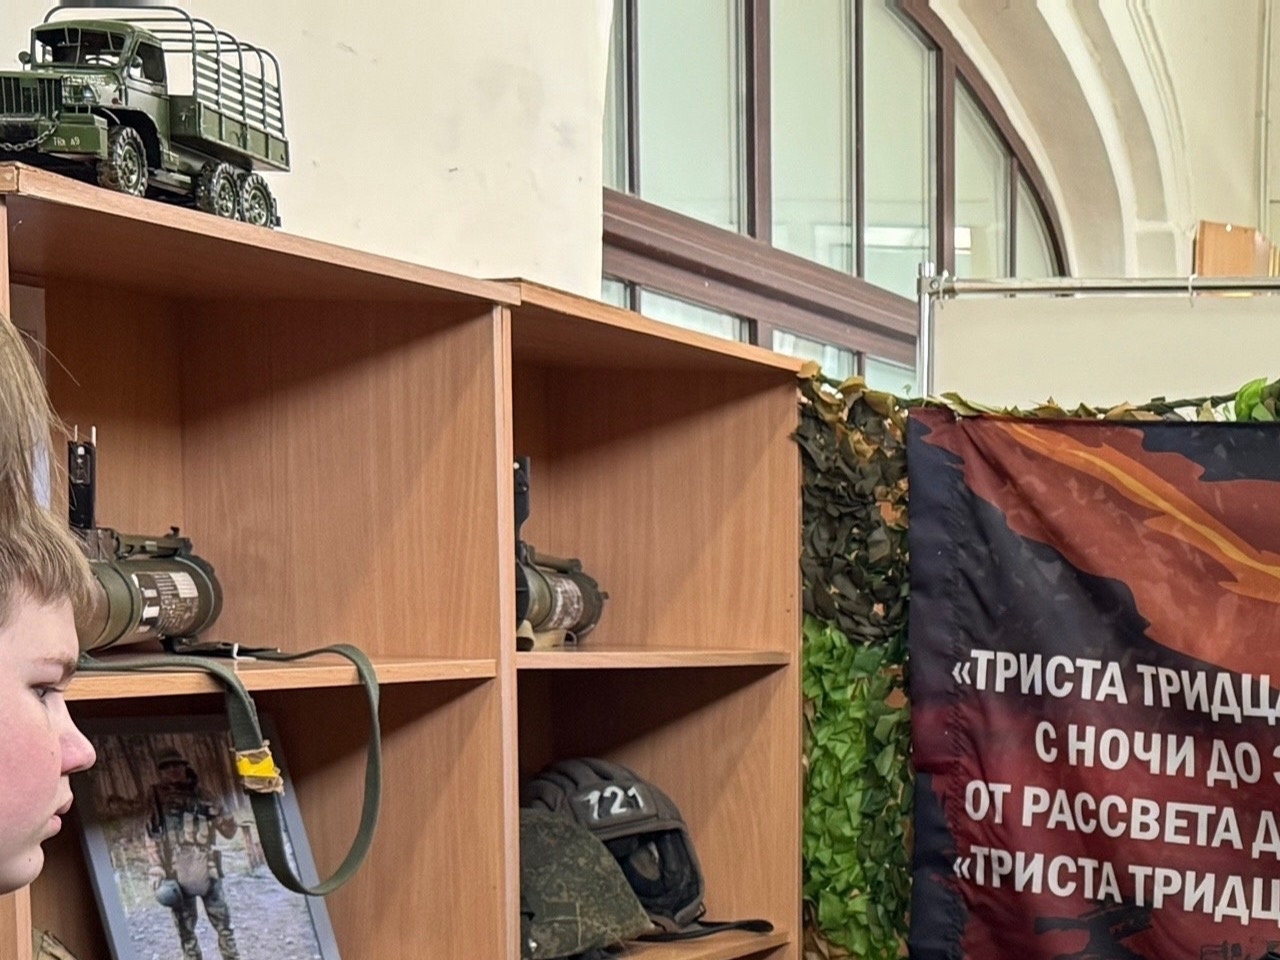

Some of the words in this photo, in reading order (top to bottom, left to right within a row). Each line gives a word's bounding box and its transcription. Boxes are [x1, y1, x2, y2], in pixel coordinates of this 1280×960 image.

[952, 649, 1128, 704] «ТРИСТА
[1035, 721, 1058, 763] С
[1067, 724, 1195, 777] НОЧИ
[1206, 739, 1262, 789] ДО
[965, 779, 1012, 824] ОТ
[1022, 785, 1244, 850] РАССВЕТА
[953, 845, 1123, 904] «ТРИСТА
